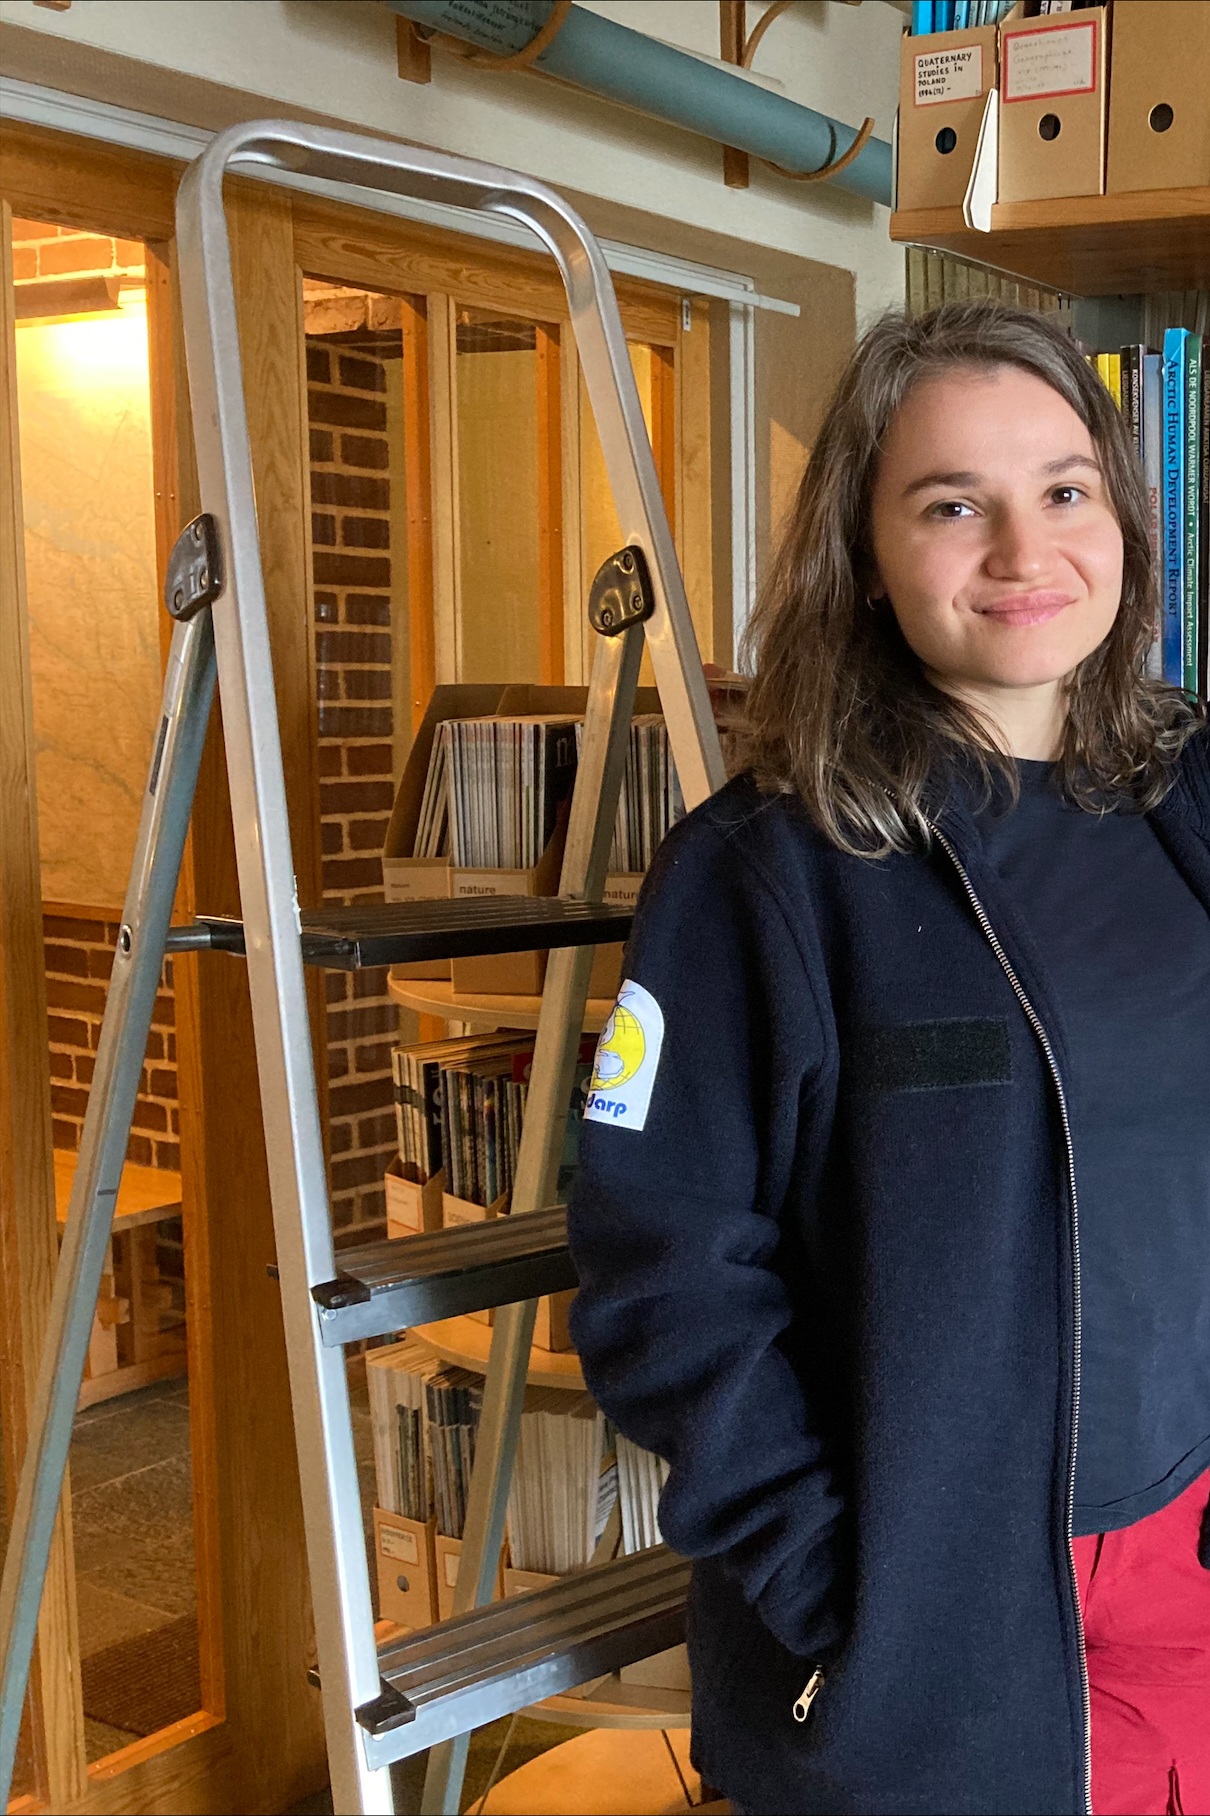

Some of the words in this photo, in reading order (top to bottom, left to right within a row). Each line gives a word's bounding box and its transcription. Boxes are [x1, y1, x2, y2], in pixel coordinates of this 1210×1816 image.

[917, 52, 972, 68] QUATERNARY
[918, 77, 946, 87] POLAND
[1167, 360, 1178, 408] ARCTIC
[1188, 377, 1196, 387] DE
[1188, 391, 1196, 442] NOORDPOOL
[1132, 425, 1138, 435] AV
[1167, 412, 1178, 464] HUMAN
[1168, 469, 1179, 564] DEVELOPMENT
[1168, 568, 1179, 617] REPORT
[1185, 592, 1194, 618] Impact
[1186, 621, 1194, 666] Assessment
[459, 884, 497, 896] nature
[603, 888, 638, 900] natur
